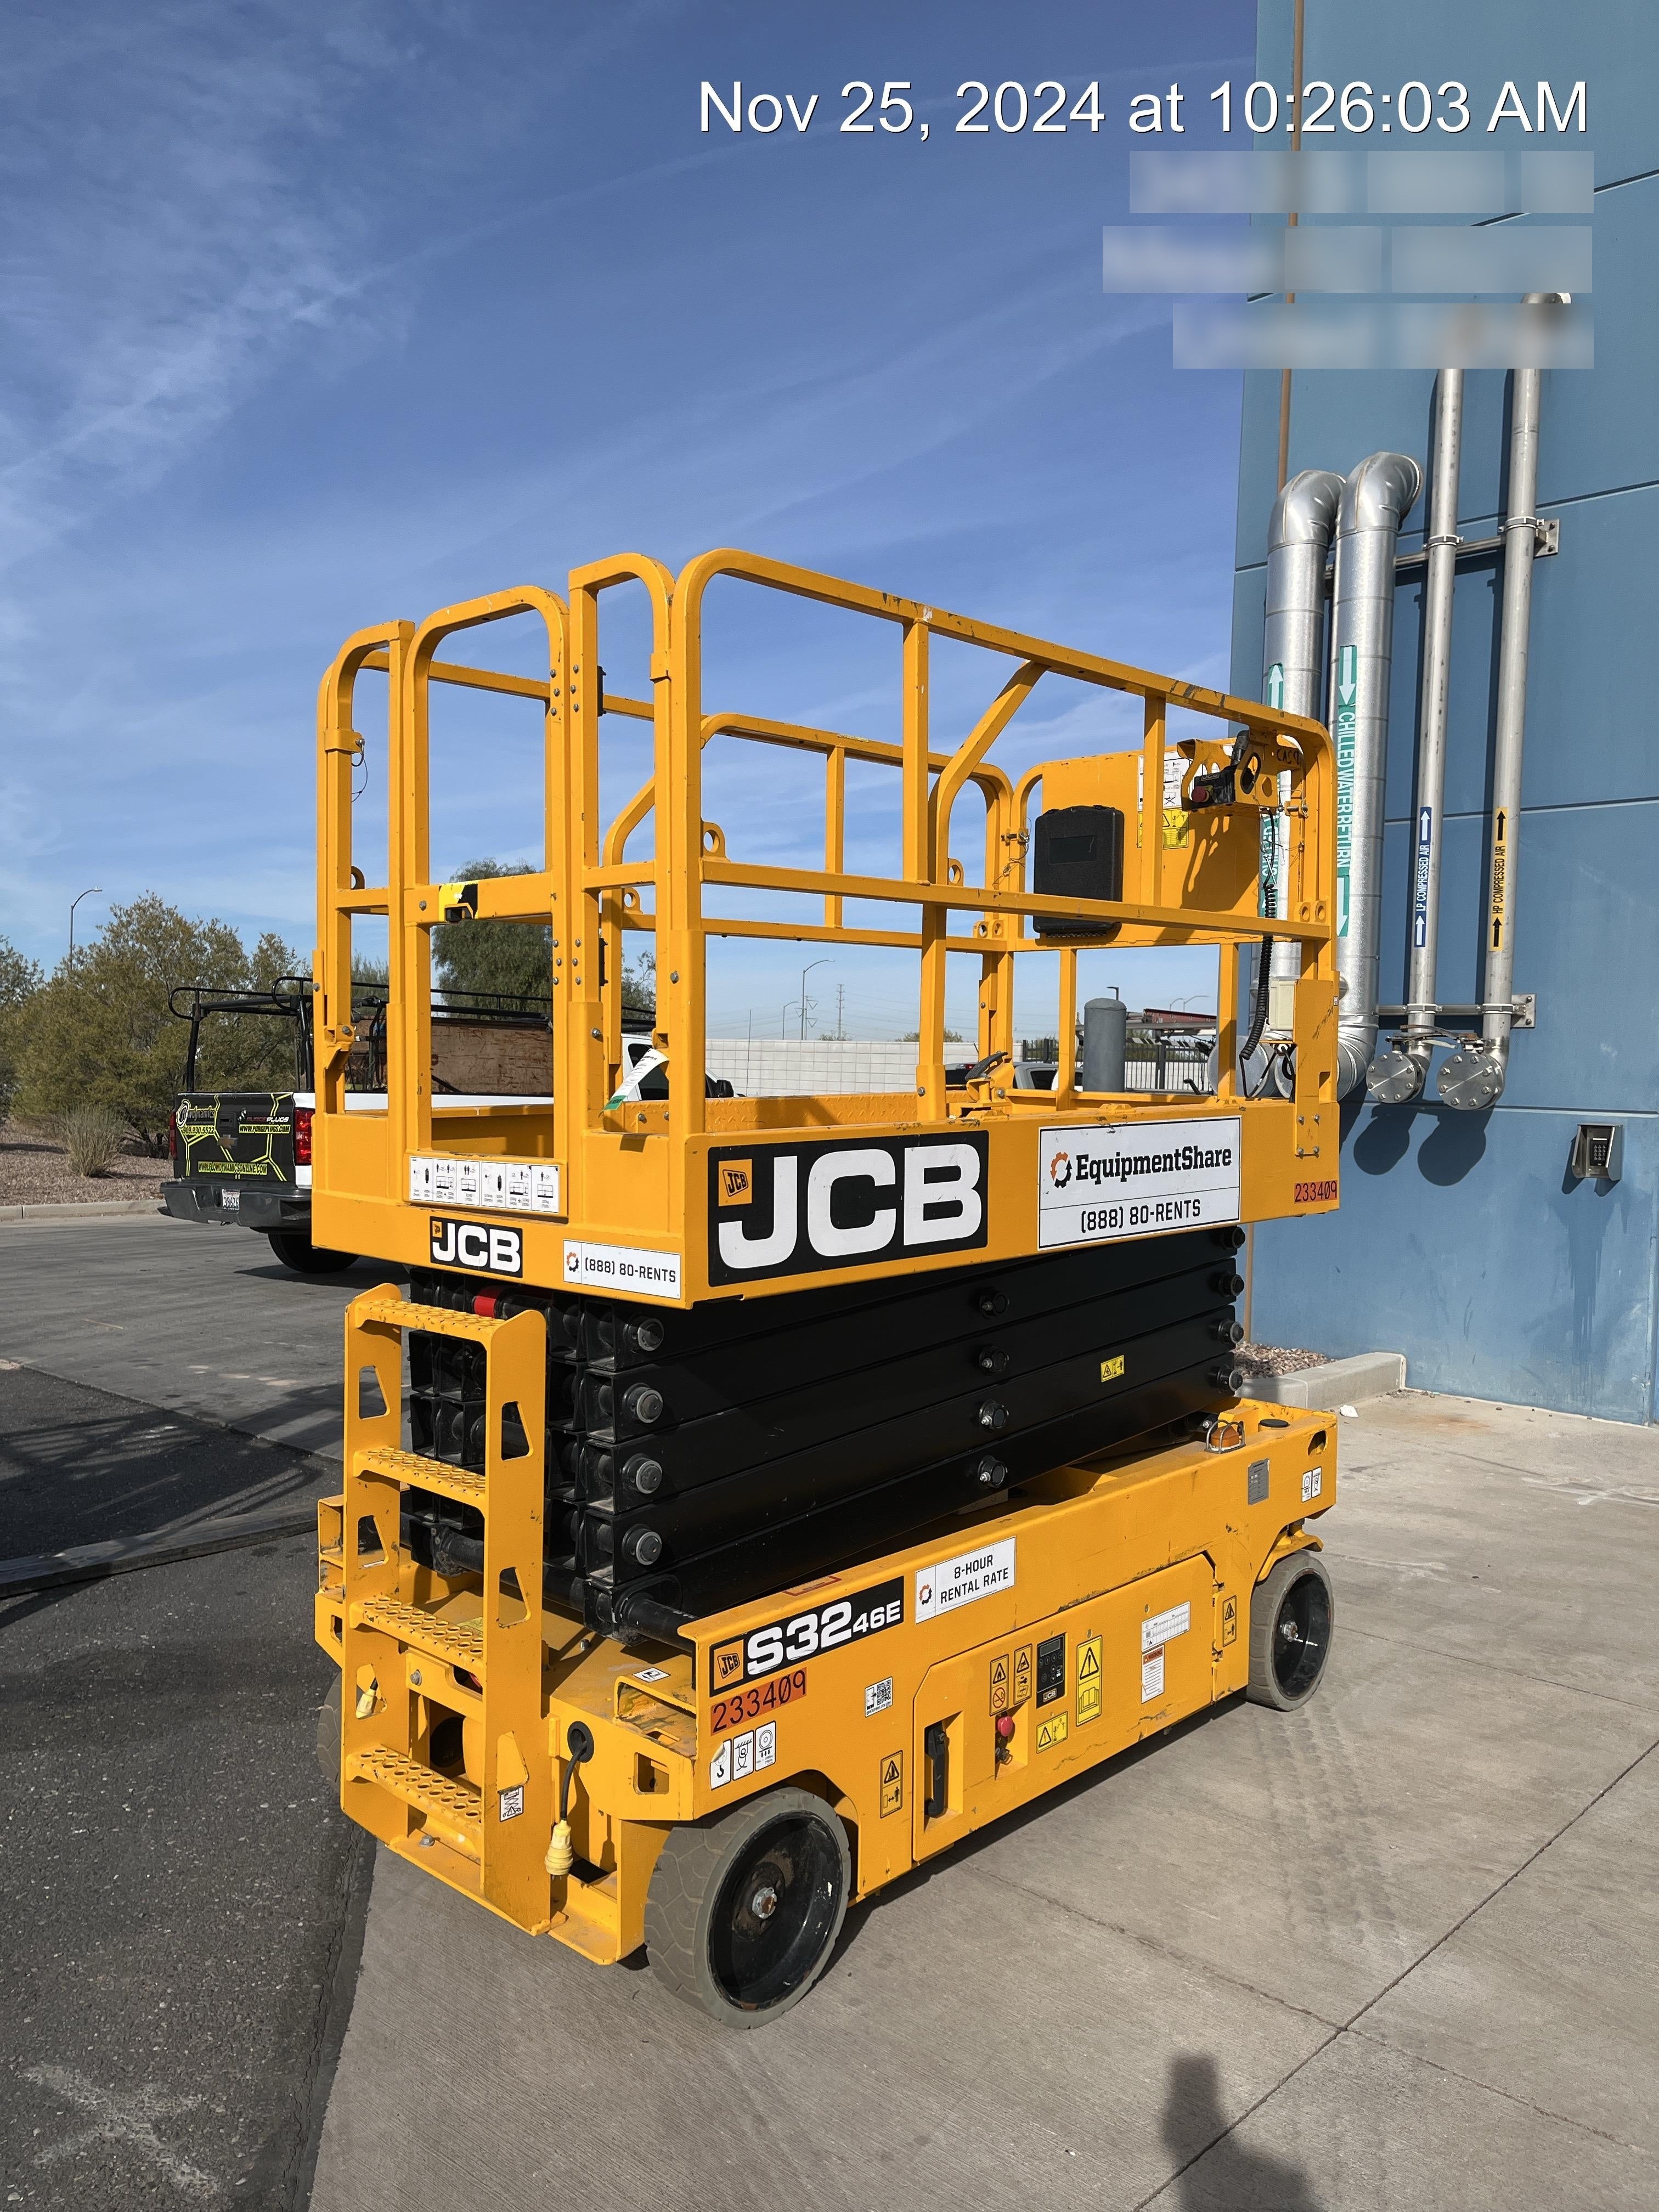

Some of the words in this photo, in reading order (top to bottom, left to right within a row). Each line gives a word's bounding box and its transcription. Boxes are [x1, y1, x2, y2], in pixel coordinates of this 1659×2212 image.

[1338, 712, 1356, 768] CHILLED
[1336, 769, 1354, 813] WATER
[1336, 815, 1352, 868] RETURN
[1419, 844, 1430, 855] AIR
[1495, 845, 1506, 856] AIR
[1417, 857, 1429, 901] COMPRESSED
[1493, 859, 1505, 903] COMPRESSED
[1415, 903, 1426, 911] LP
[1492, 905, 1503, 914] HP
[1075, 1145, 1233, 1186] EquipmentShare
[727, 1171, 747, 1196] JCB
[1295, 1180, 1337, 1203] 233409
[718, 1143, 982, 1269] JCB
[1080, 1206, 1124, 1233] (888)
[1130, 1198, 1201, 1226] 80-RENTS
[432, 1222, 521, 1272] JCB
[585, 1257, 615, 1275] (888)
[619, 1263, 676, 1283] 80-RENTS
[954, 1554, 994, 1579] 8-HOUR
[940, 1579, 980, 1604] RENTAL
[983, 1567, 1009, 1587] RATE
[721, 1654, 738, 1676] JCB
[712, 1669, 806, 1734] 233409
[1044, 1690, 1056, 1700] JCB
